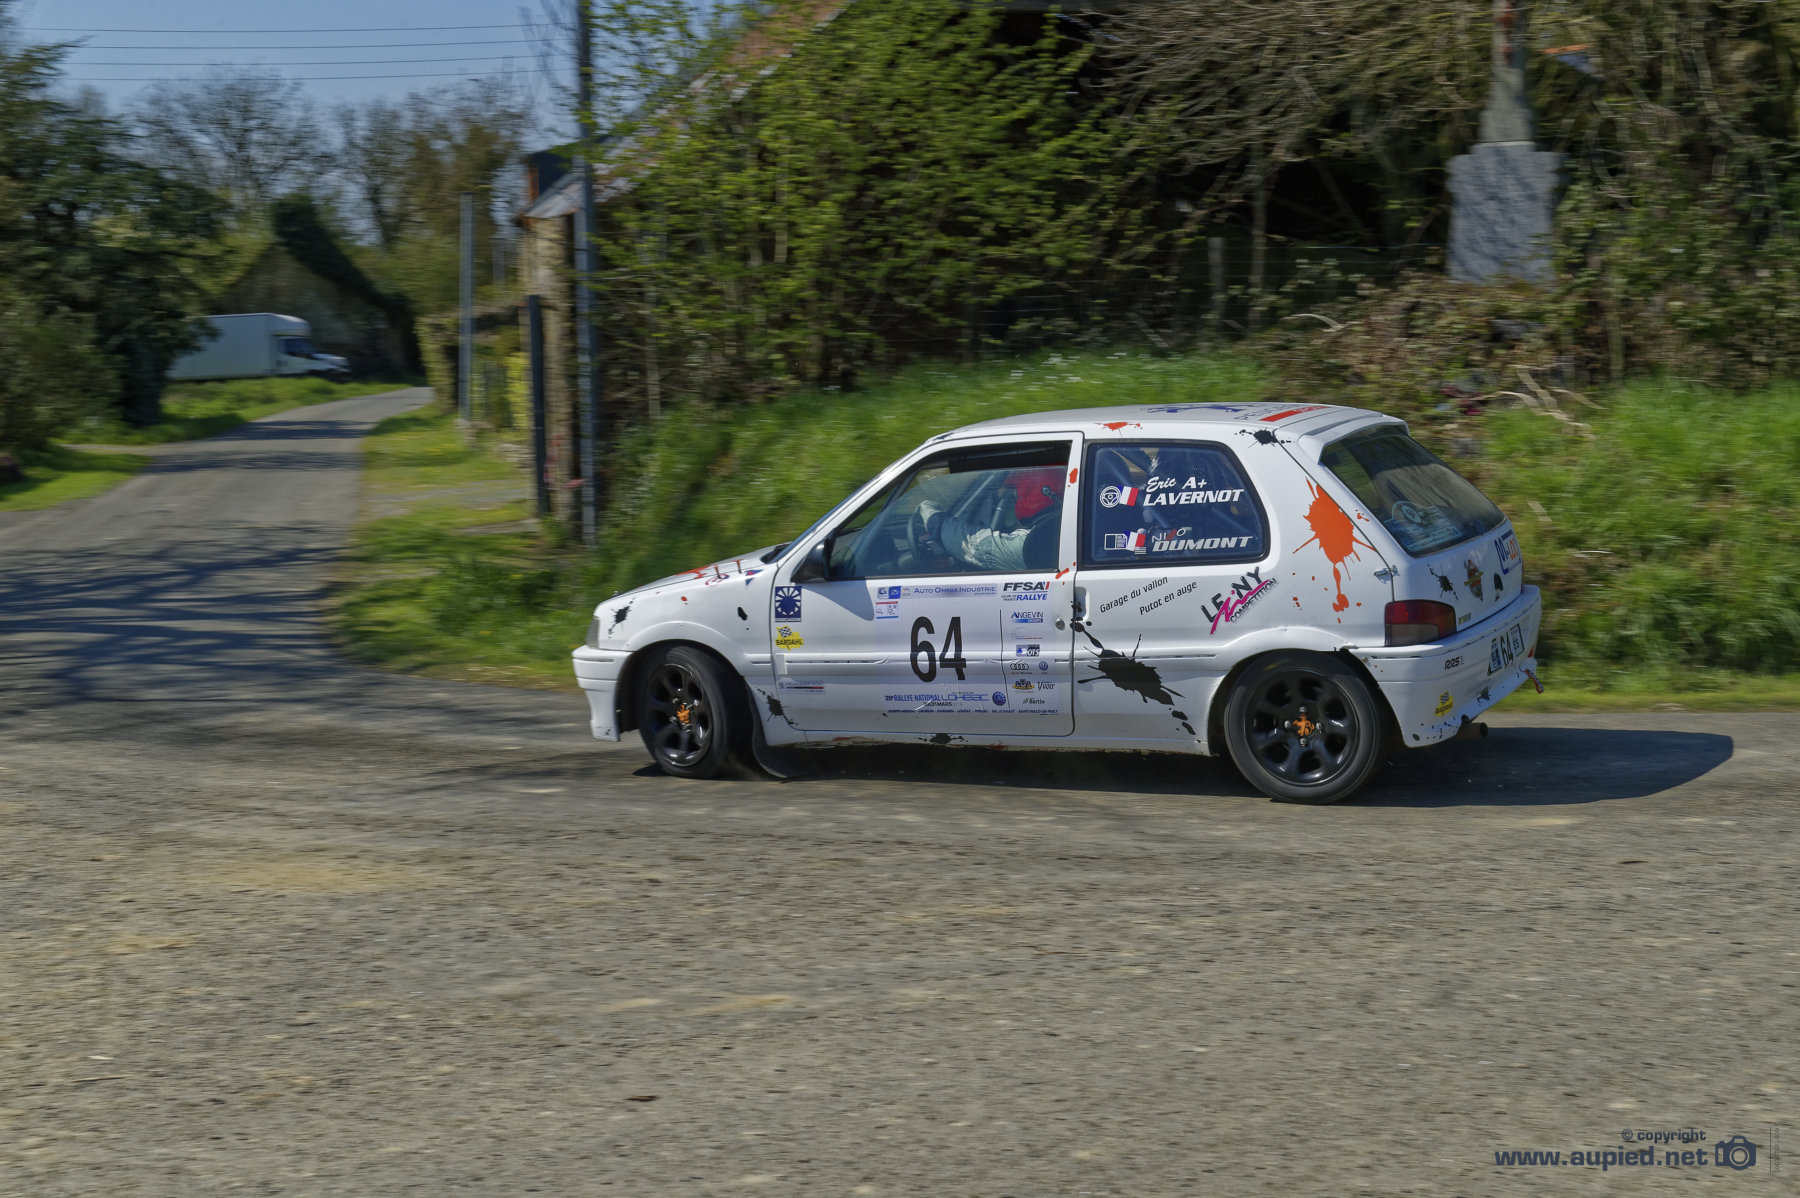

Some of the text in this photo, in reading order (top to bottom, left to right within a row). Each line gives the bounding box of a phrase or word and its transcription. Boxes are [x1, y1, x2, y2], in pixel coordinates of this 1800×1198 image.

[1146, 476, 1207, 493] Eric A+
[1143, 489, 1245, 506] LAVERNOT
[1152, 528, 1186, 543] NIO
[1152, 536, 1253, 552] DUMONT
[1003, 581, 1044, 591] FFSA
[1100, 576, 1169, 613] Garage du vallon
[1016, 593, 1048, 601] RALLYE
[1139, 581, 1198, 615] Putot en auge
[909, 616, 967, 682] 64
[1500, 631, 1514, 667] 64
